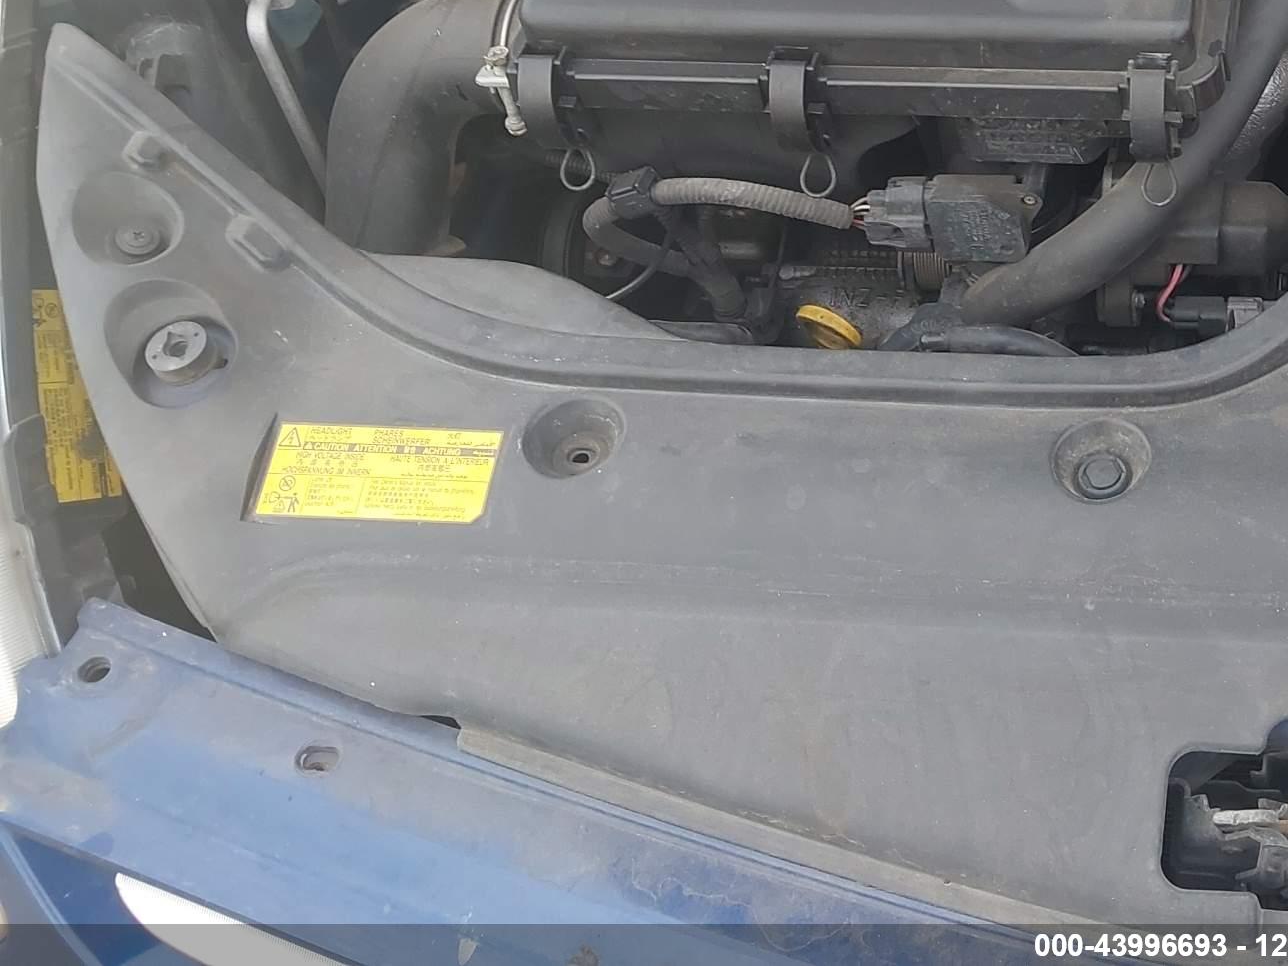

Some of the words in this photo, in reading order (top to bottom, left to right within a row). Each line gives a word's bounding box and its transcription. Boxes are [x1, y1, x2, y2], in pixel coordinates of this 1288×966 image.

[310, 426, 353, 435] HEADLIGHT
[373, 428, 404, 436] PHARES
[314, 442, 350, 452] CAUTION
[352, 443, 398, 453] ATTENTION
[422, 445, 462, 455] ACHTUNG
